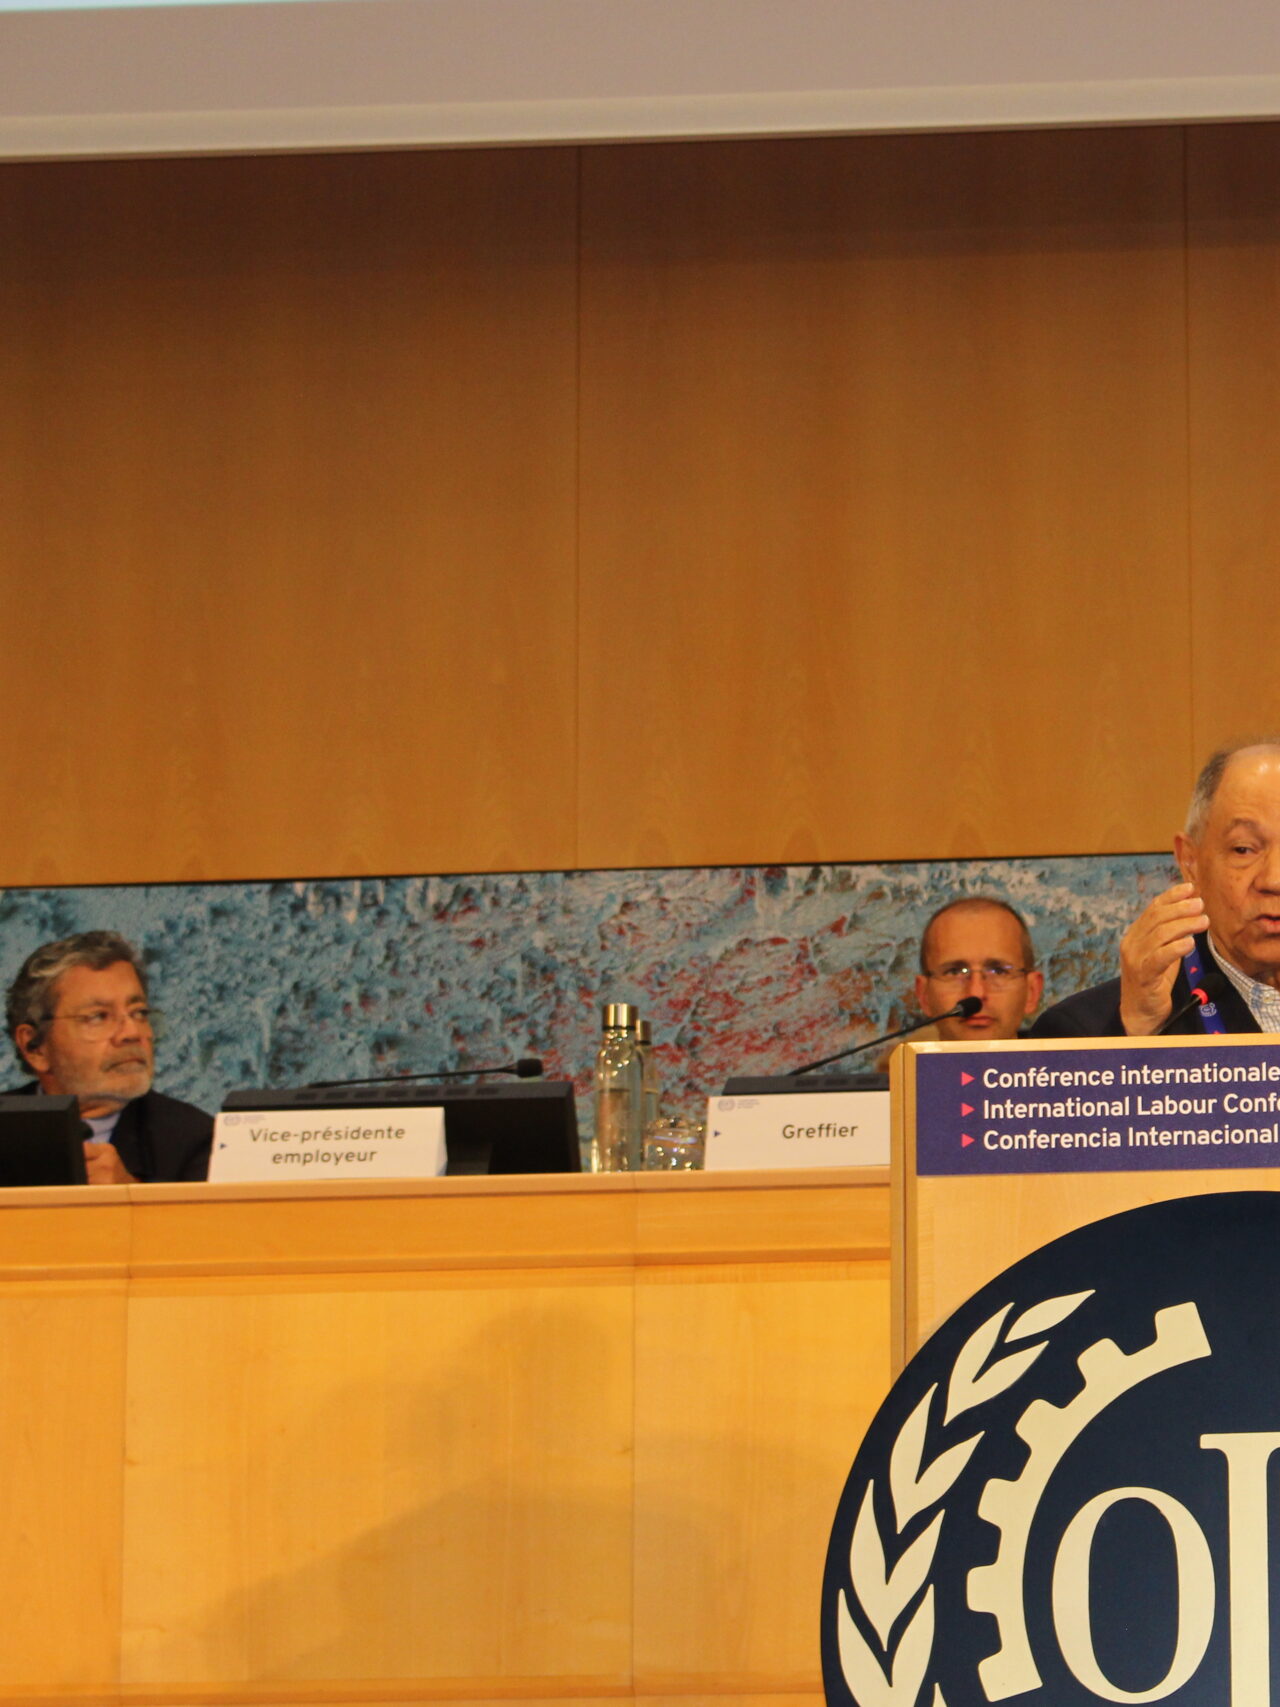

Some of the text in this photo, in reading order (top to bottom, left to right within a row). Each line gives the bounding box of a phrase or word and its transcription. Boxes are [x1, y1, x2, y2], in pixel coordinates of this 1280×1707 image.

[983, 1066, 1115, 1089] Conférence
[983, 1096, 1130, 1120] International
[1137, 1094, 1218, 1116] Labour
[250, 1125, 405, 1143] Vice-présidente
[782, 1123, 858, 1139] Greffier
[983, 1126, 1122, 1151] Conferencia
[1128, 1122, 1279, 1147] Internacional
[271, 1149, 377, 1165] employeur
